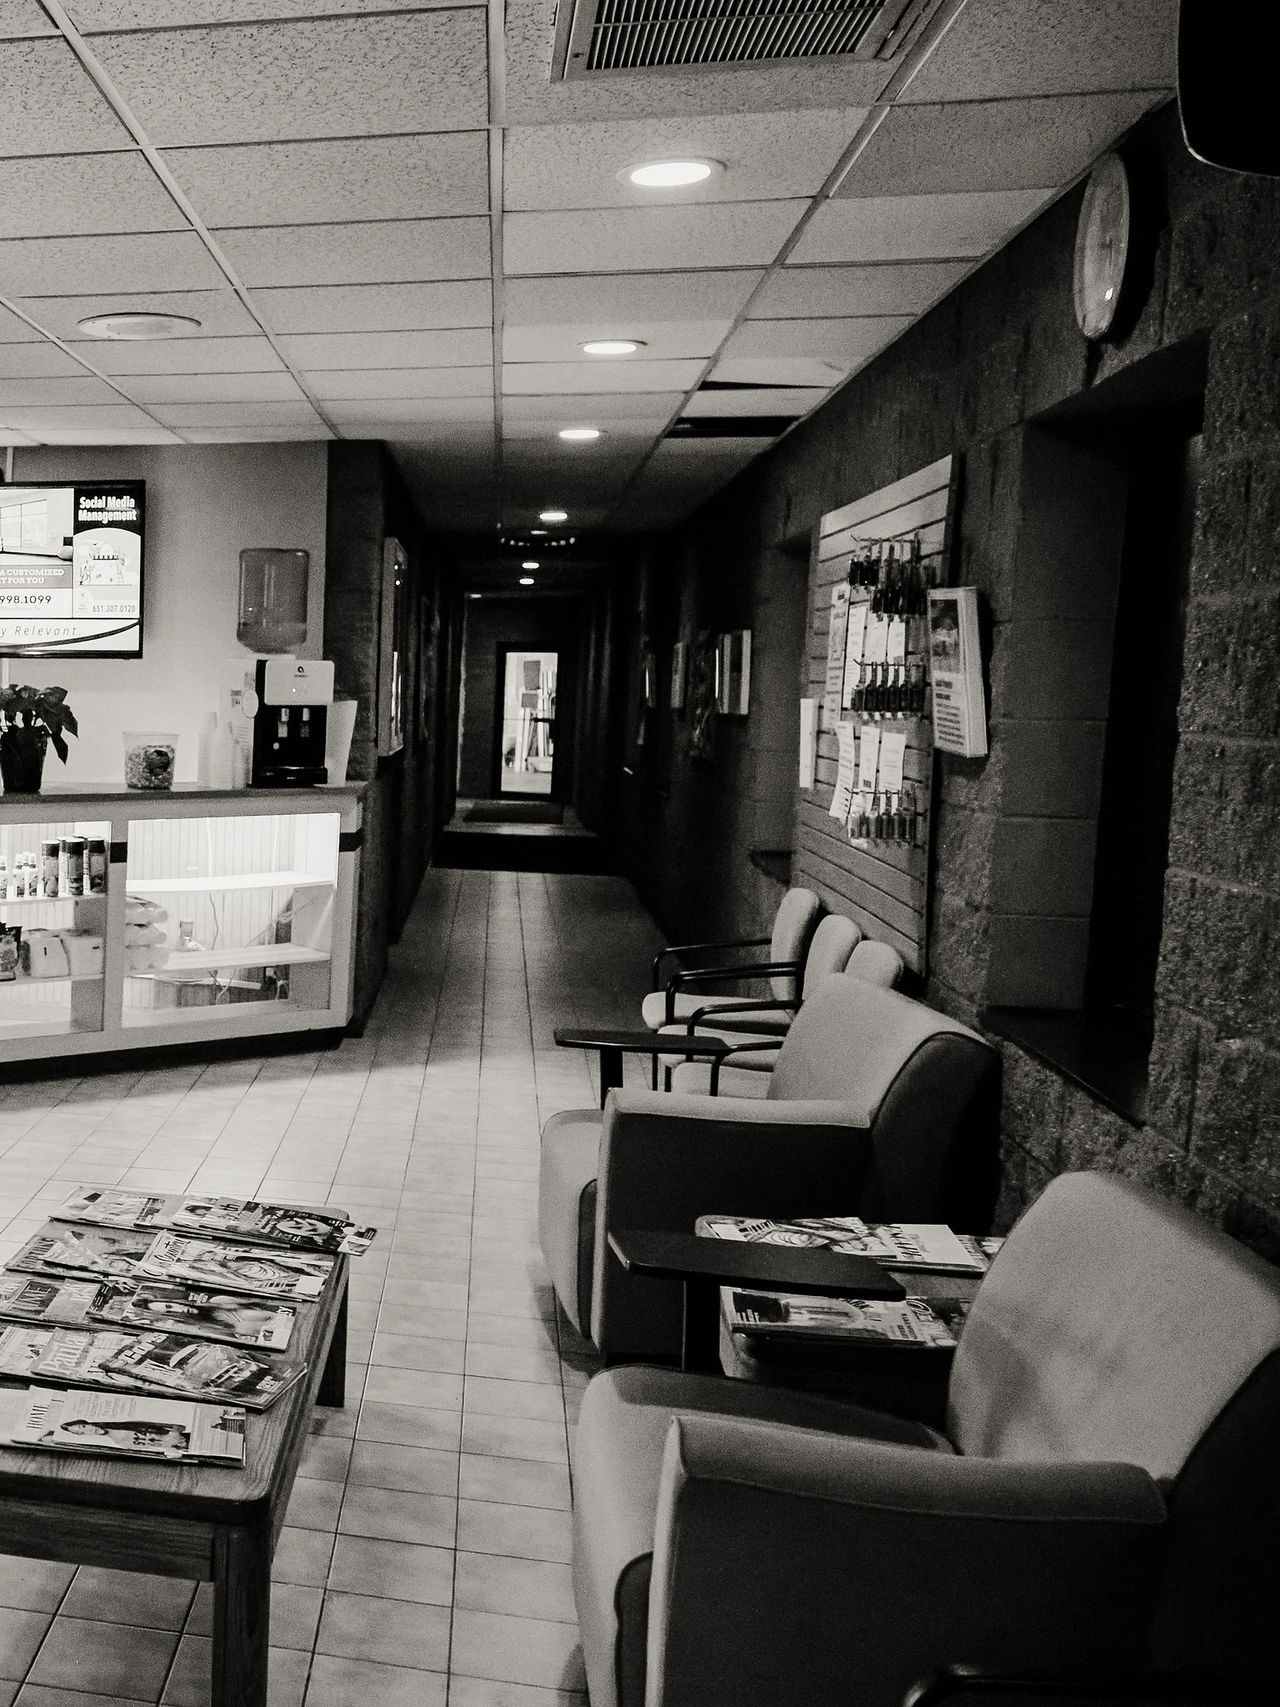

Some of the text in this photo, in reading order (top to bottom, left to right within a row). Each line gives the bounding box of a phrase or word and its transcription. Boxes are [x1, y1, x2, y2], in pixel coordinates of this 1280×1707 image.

[80, 496, 135, 508] Social Media
[78, 510, 137, 523] Management
[6, 569, 65, 577] CUSTOMIZED
[8, 577, 25, 585] FOR
[25, 577, 45, 585] YOU
[92, 604, 137, 613] 651.307.0120
[14, 625, 81, 636] Relevant.
